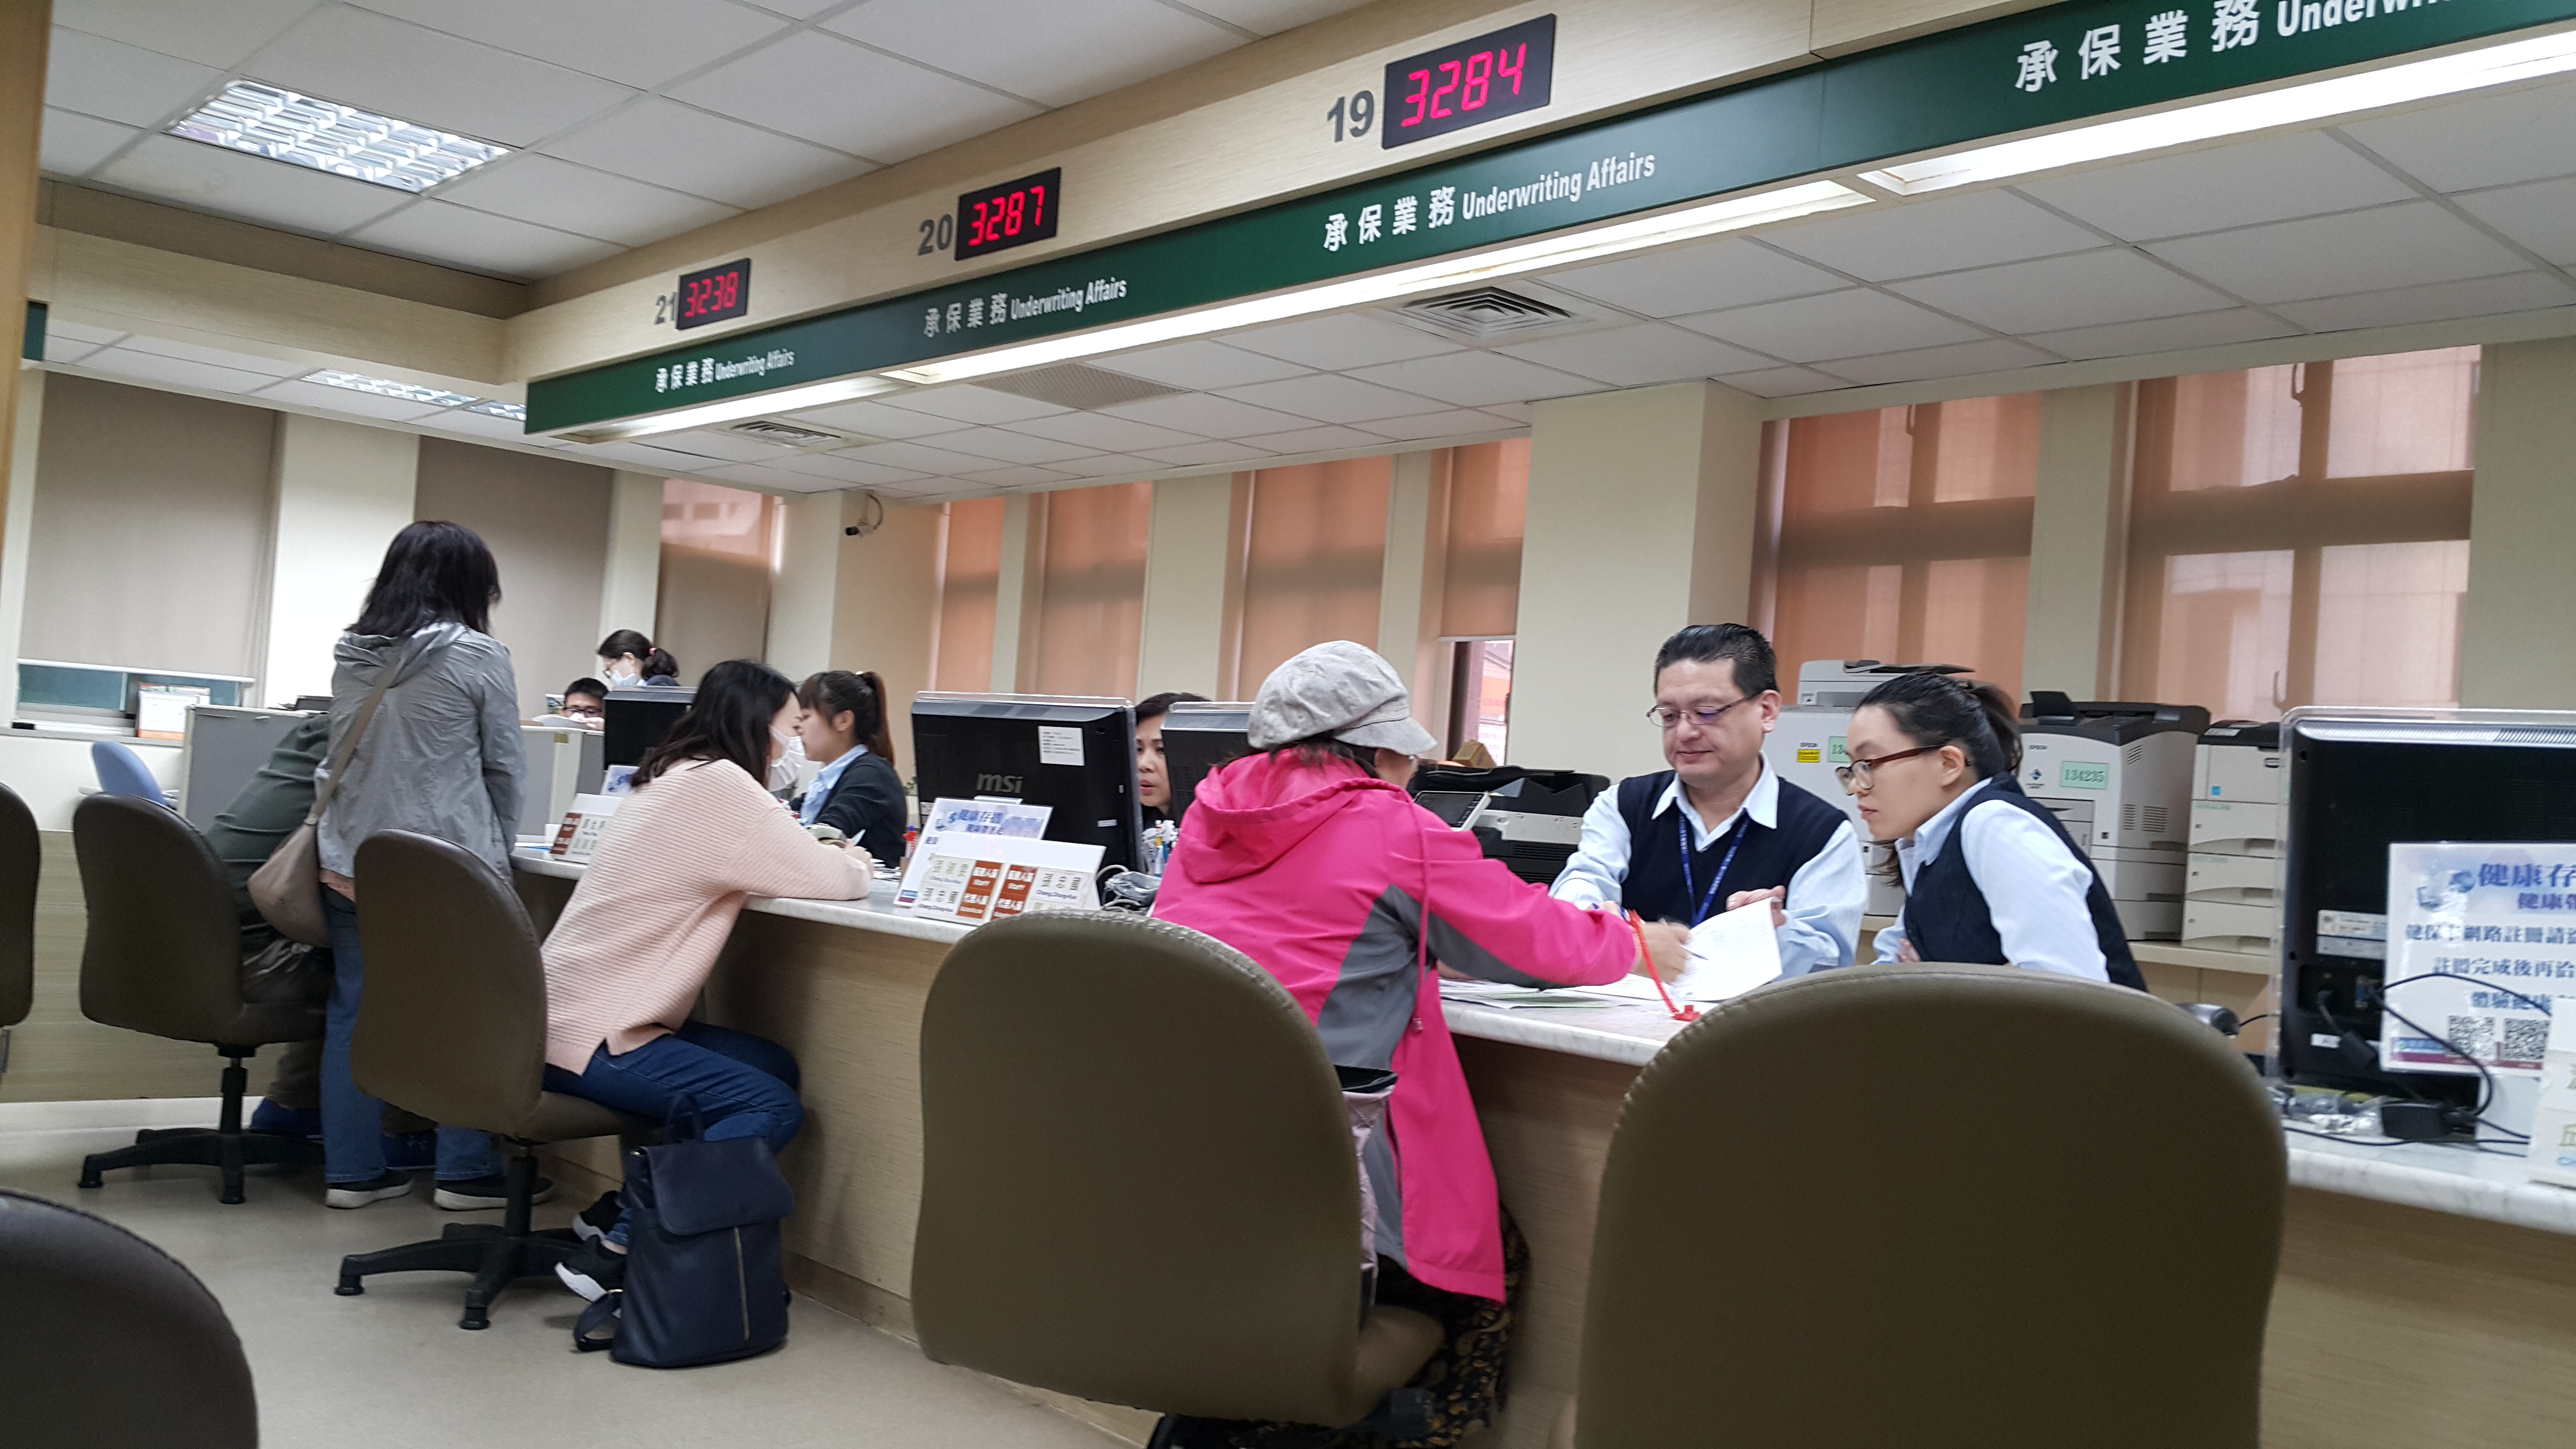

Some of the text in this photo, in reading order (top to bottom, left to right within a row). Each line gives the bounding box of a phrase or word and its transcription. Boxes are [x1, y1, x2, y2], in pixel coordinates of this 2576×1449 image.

[2015, 0, 2455, 92] 承保業務 Underw
[1401, 43, 1527, 128] 3284
[1326, 90, 1374, 143] 19
[968, 185, 1046, 247] 3287
[1323, 152, 1656, 252] 承保業務 Underwriting Affairs
[918, 213, 954, 256] 20
[654, 291, 678, 325] 21
[684, 271, 739, 318] 3238
[923, 277, 1127, 338] 承保業務 Underwriting Affairs
[976, 773, 1024, 793] msi
